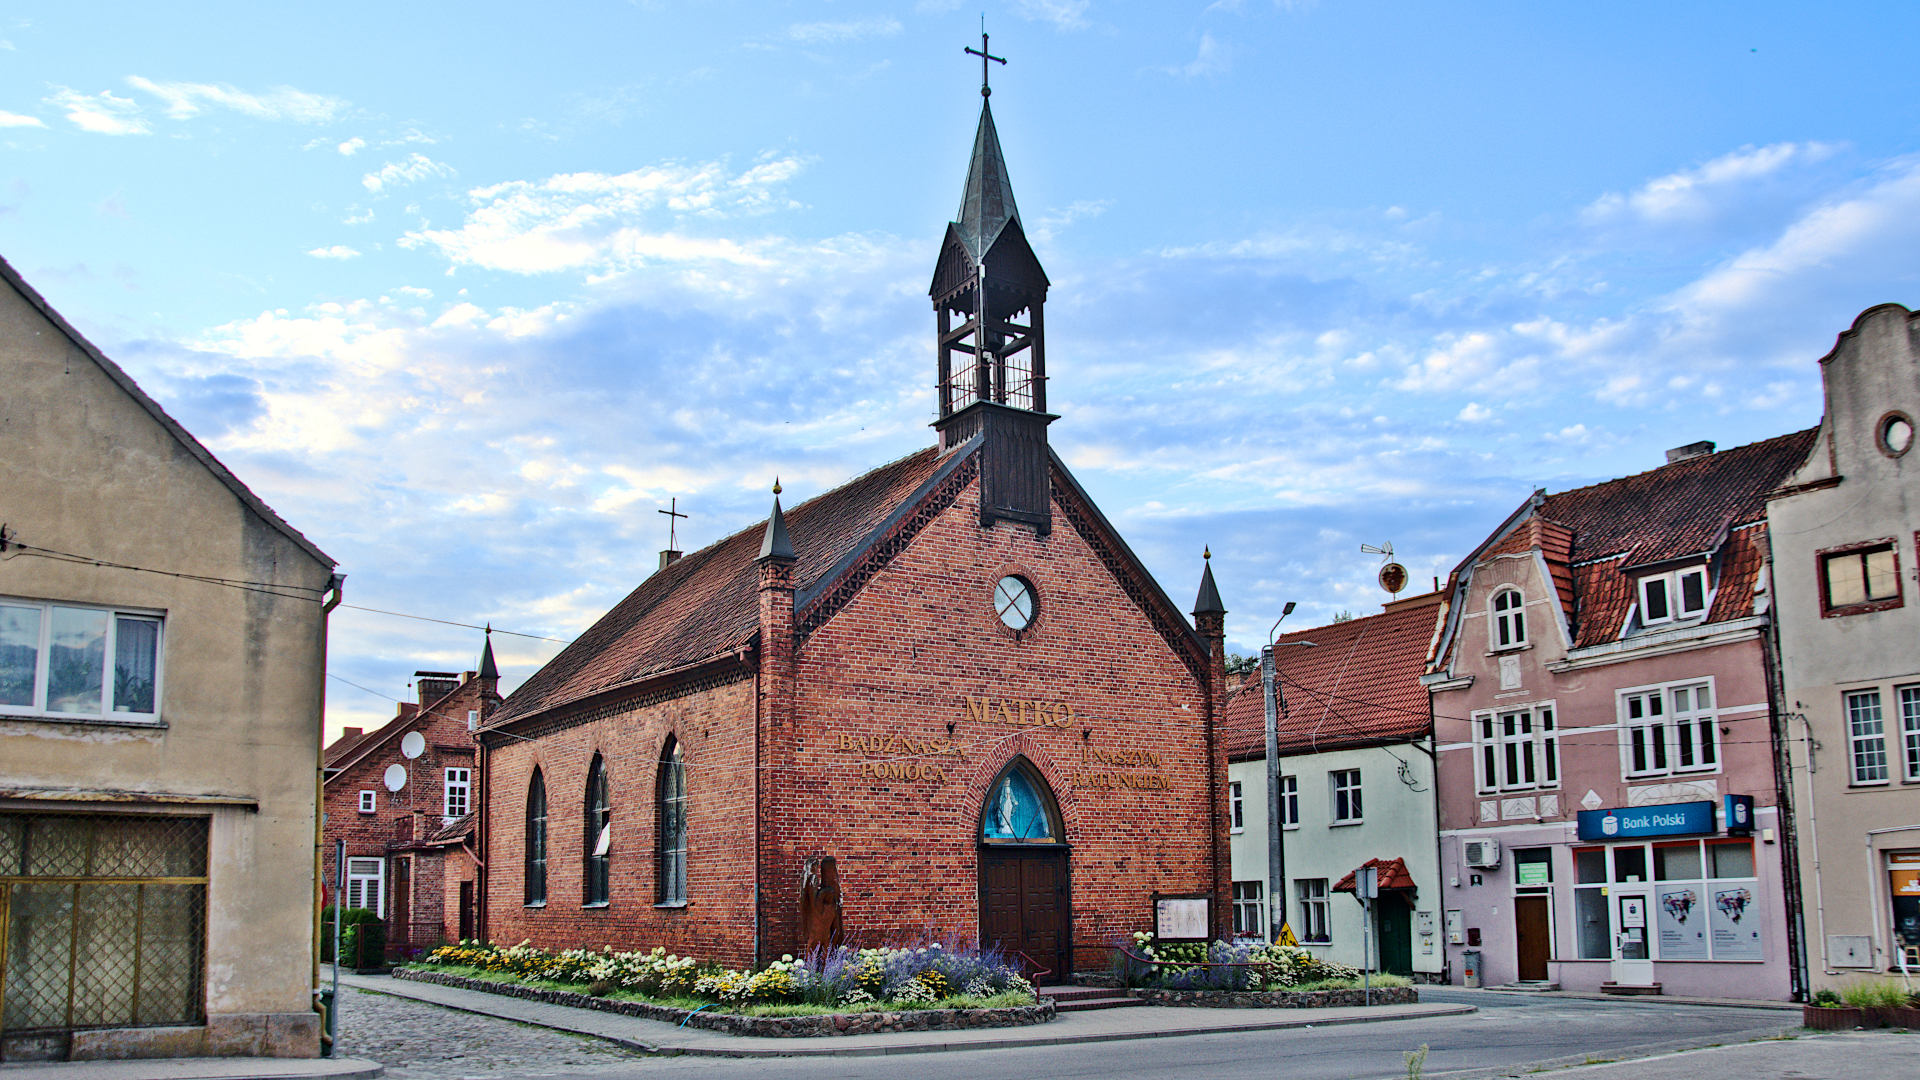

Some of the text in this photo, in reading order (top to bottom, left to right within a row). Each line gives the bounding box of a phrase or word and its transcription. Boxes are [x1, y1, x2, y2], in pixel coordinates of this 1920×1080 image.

[963, 696, 1075, 729] MATKO
[839, 733, 967, 760] BĄDŹ NASZĄ
[1082, 748, 1160, 766] I NASZYM
[861, 763, 948, 786] POMOCĄ
[1072, 771, 1170, 789] RATUNKIEM
[1622, 813, 1686, 829] Bank Polski
